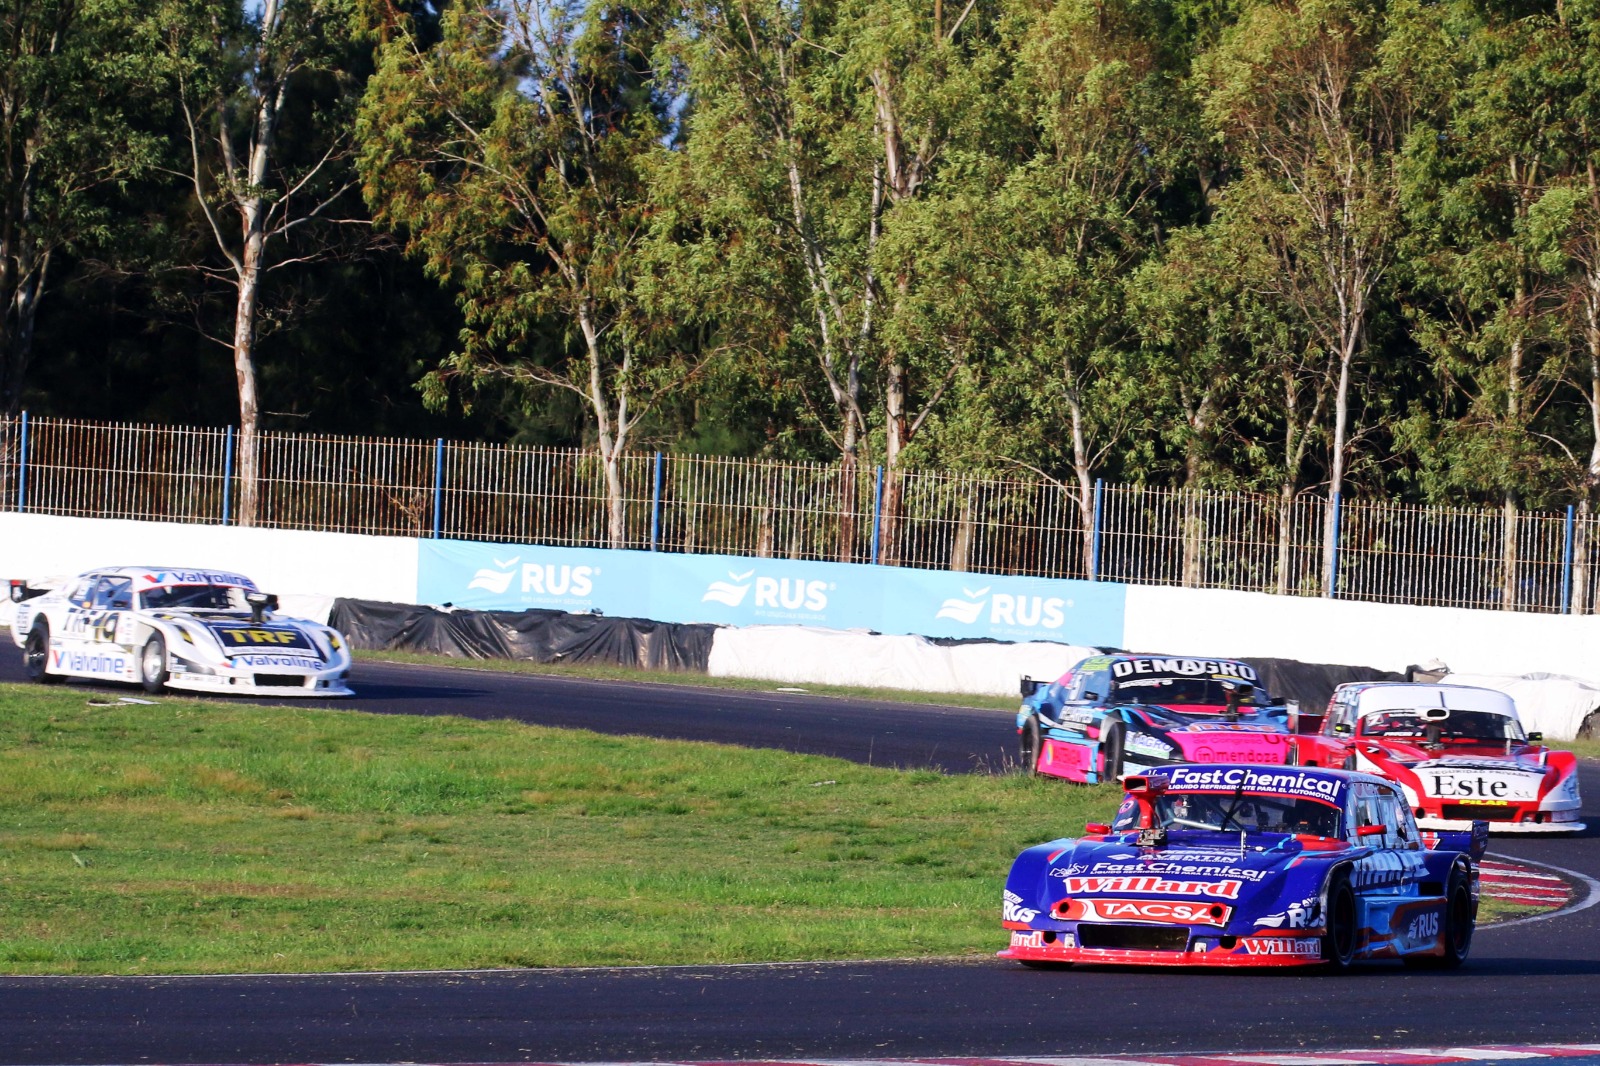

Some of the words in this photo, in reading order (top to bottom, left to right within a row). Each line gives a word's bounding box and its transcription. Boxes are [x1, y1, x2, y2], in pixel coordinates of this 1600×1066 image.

[172, 572, 255, 589] Valvoline
[222, 629, 297, 643] TRF
[241, 656, 323, 670] Valvoline
[1112, 658, 1257, 680] DEMAGRO
[1216, 749, 1279, 763] mendoza
[1256, 785, 1277, 793] PARA
[1288, 788, 1336, 803] AUTOMOTOR
[1431, 775, 1508, 798] Este
[1459, 798, 1508, 806] PILAR
[1213, 873, 1261, 882] AUTOMOTOR
[1062, 876, 1243, 899] Willard
[1003, 900, 1036, 923] RUS
[1418, 911, 1440, 937] RUS
[1242, 937, 1321, 955] Willard
